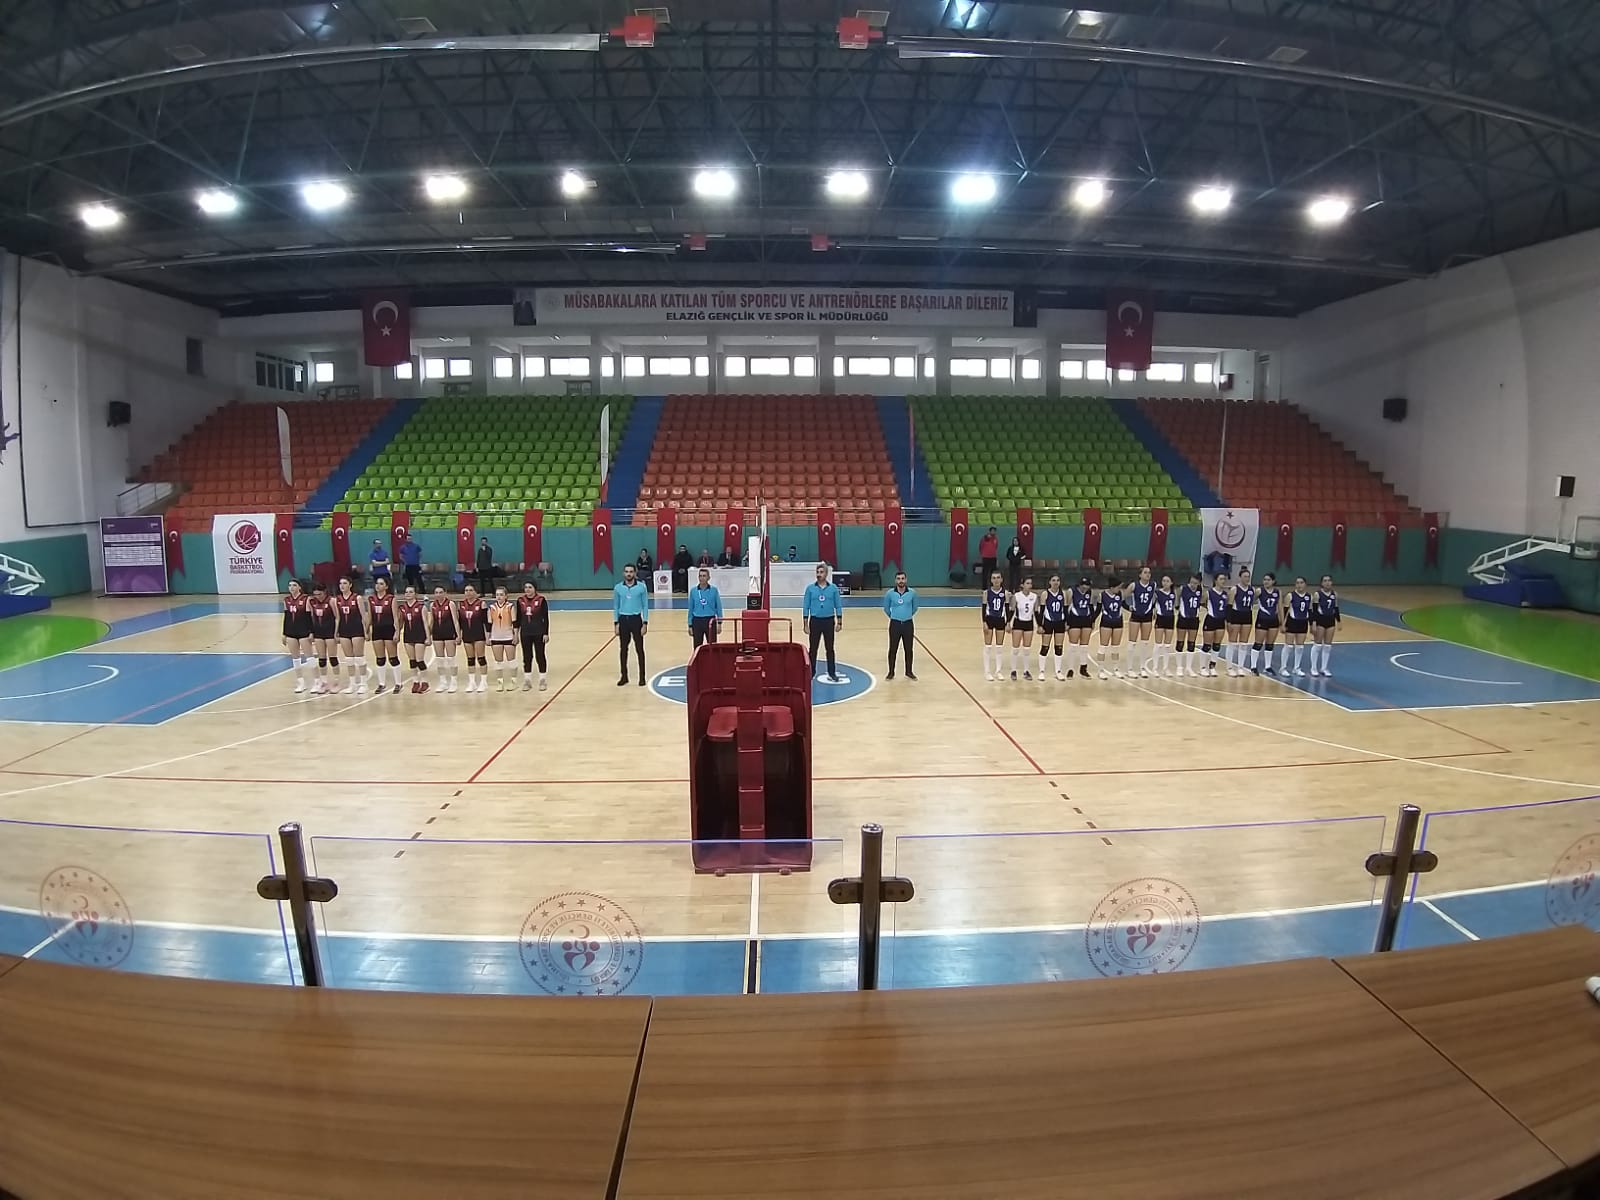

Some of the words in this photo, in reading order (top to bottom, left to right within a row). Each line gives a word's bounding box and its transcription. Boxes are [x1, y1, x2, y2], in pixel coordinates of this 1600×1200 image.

[564, 291, 657, 309] MÜSABAKALARA
[661, 293, 708, 308] KATILAN
[711, 291, 736, 308] TÜM
[740, 293, 786, 308] SPORCU
[791, 293, 805, 308] VE
[808, 291, 897, 309] ANTRENÖRLERE
[900, 294, 963, 312] BAŞARILAR
[966, 292, 1008, 311] DİLERİZ
[666, 310, 706, 320] ELAZIĞ
[708, 311, 755, 322] GENÇLİK
[758, 312, 772, 321] VE
[774, 312, 804, 321] SPOR
[806, 310, 817, 321] İL
[819, 311, 889, 322] MÜDÜRLÜĞÜ
[229, 555, 263, 564] TÜRKİYE
[1140, 593, 1149, 603] 15
[1189, 597, 1198, 608] 16
[1243, 596, 1251, 607] 11
[1266, 598, 1276, 608] 17
[1052, 601, 1061, 612] 10
[1109, 602, 1119, 612] 12
[1165, 600, 1173, 611] 13
[1219, 600, 1224, 611] 2
[1327, 599, 1332, 609] 7
